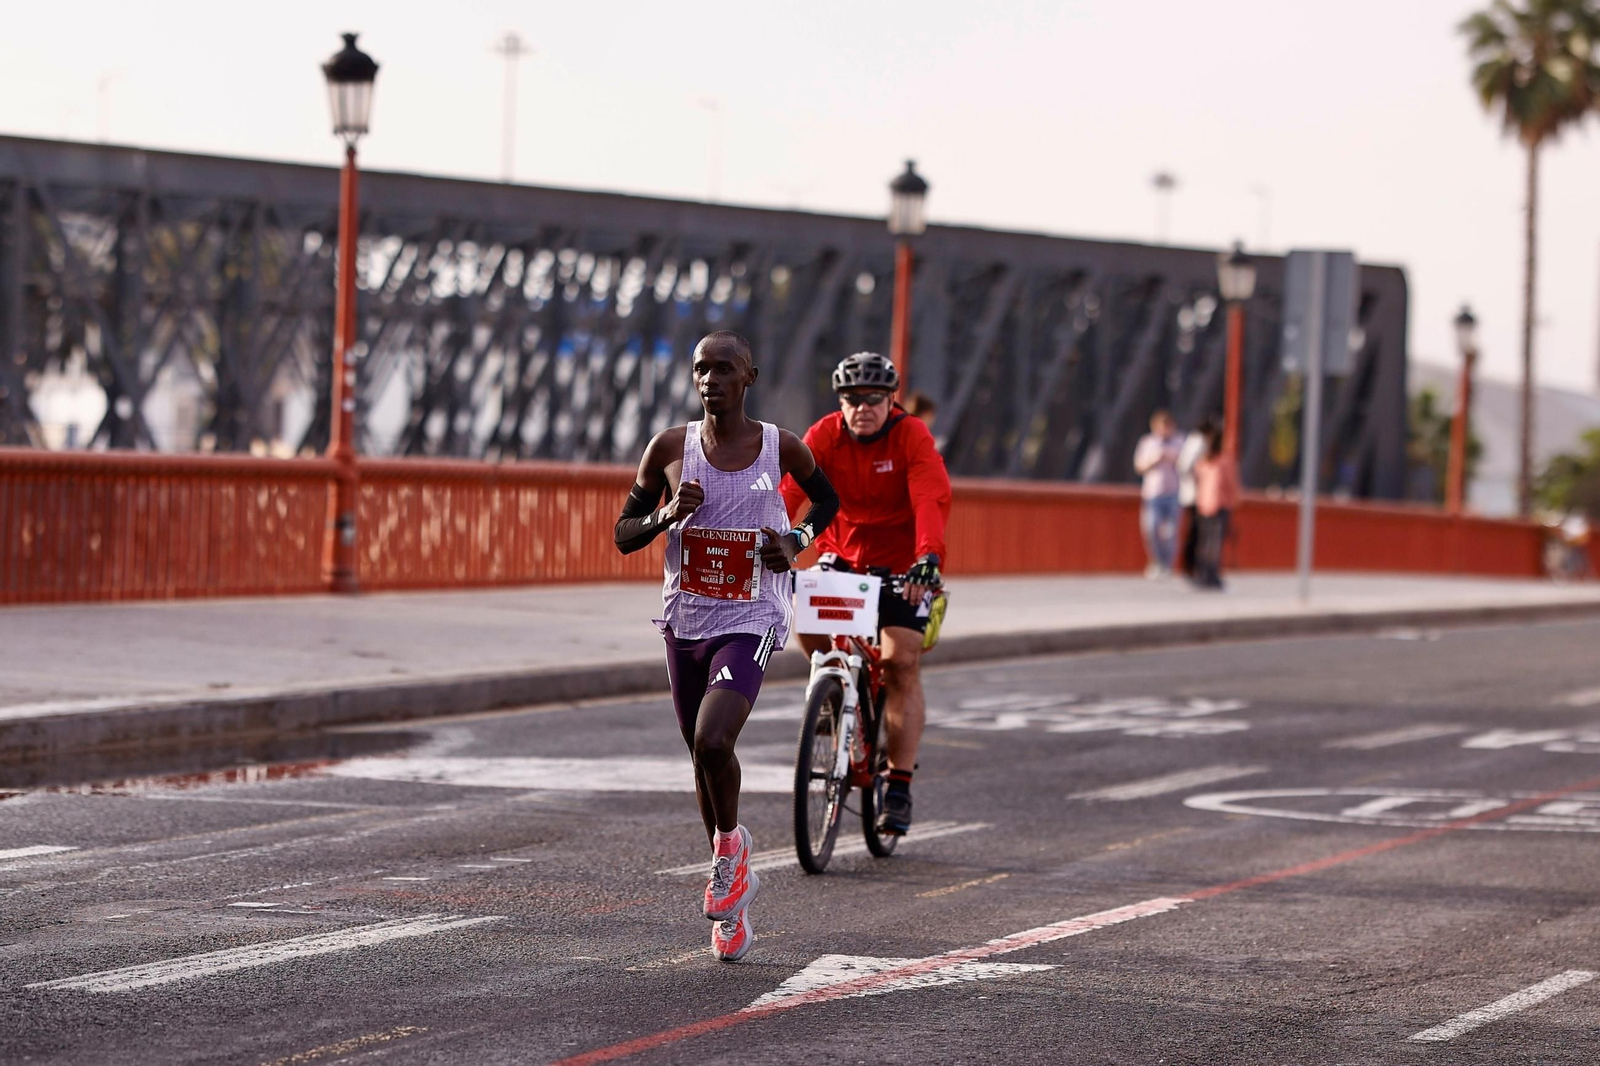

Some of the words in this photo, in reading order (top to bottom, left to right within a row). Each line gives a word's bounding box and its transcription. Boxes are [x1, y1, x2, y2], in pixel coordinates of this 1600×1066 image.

[701, 529, 751, 542] GENERALI
[706, 546, 730, 557] MIKE
[711, 560, 723, 569] 14
